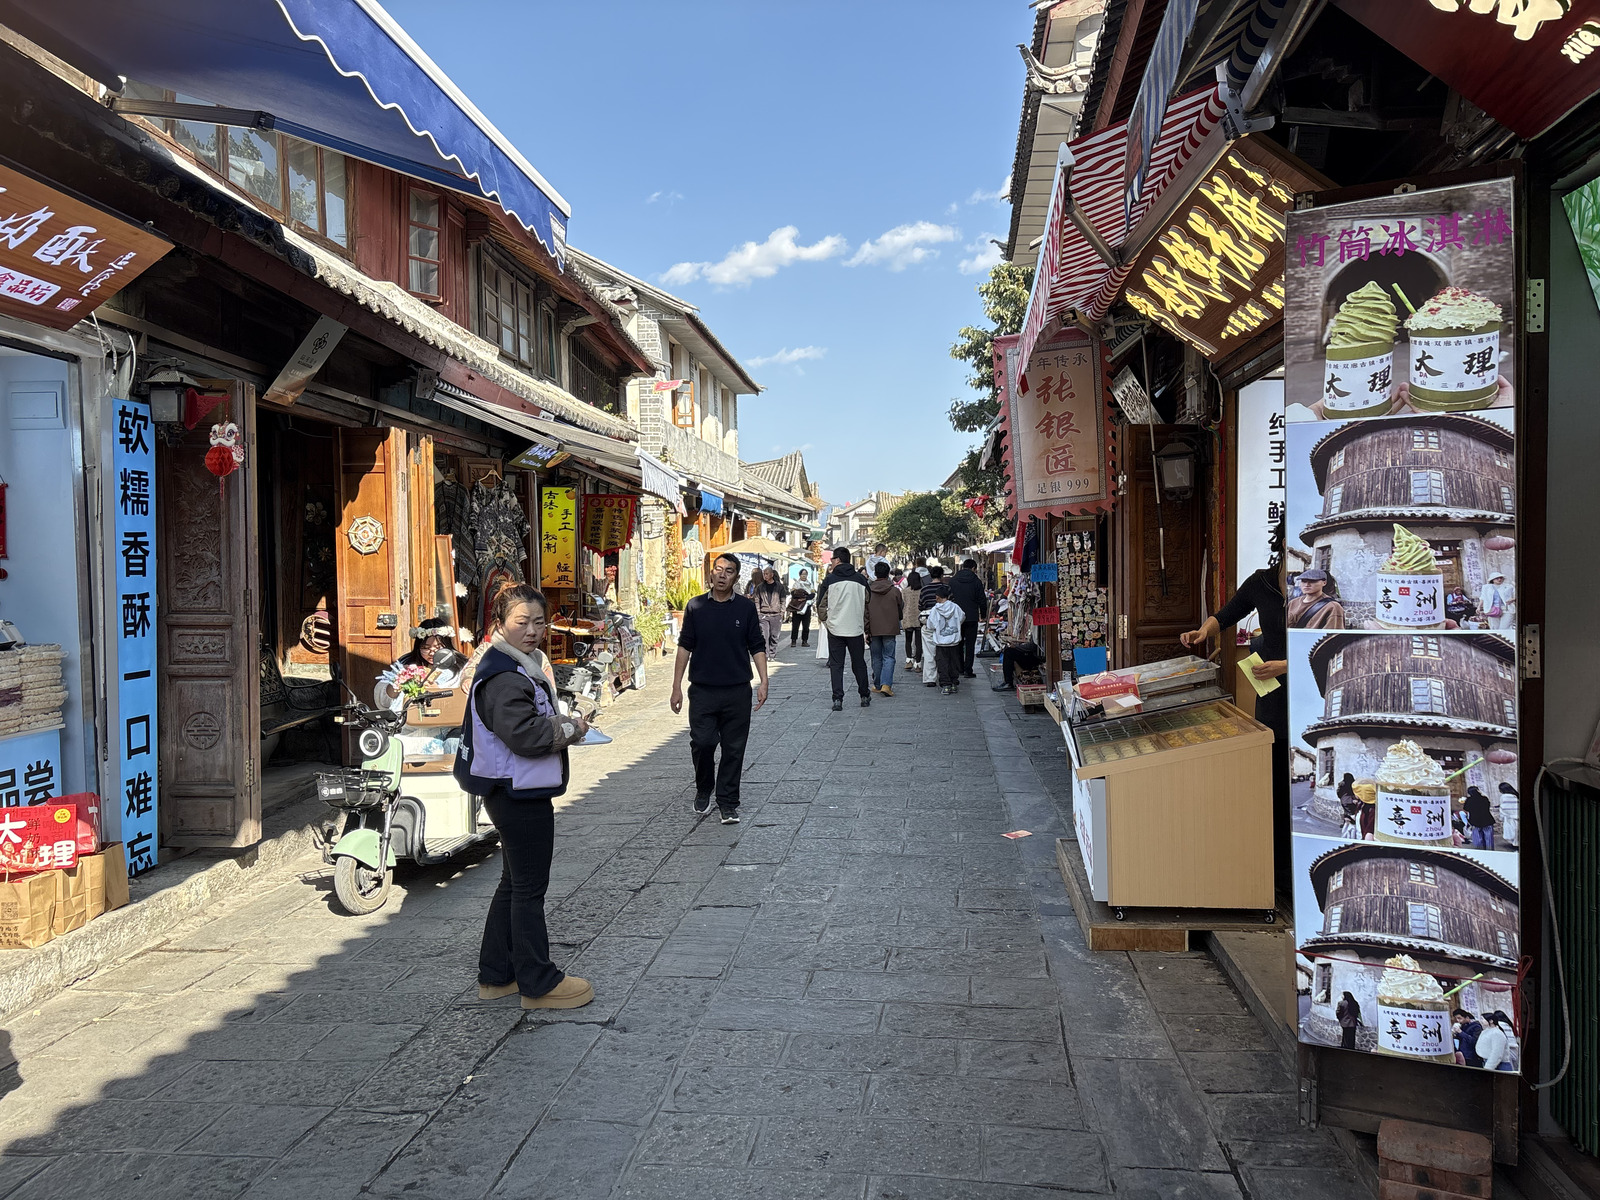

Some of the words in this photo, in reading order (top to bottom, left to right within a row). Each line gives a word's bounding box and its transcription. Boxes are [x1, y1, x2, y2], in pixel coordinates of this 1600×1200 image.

[1294, 207, 1514, 268] 竹筒冰淇淋
[1415, 345, 1496, 377] 大理
[1325, 364, 1392, 398] 大理
[1035, 371, 1081, 477] 张银匠
[543, 490, 559, 510] 古法
[558, 508, 575, 532] 手工
[1378, 585, 1438, 610] 喜洲
[118, 404, 153, 878] 软糯香酥一口难忘
[1387, 804, 1445, 827] 喜洲
[0, 812, 76, 868] 大理
[1385, 1017, 1443, 1044] 喜洲
